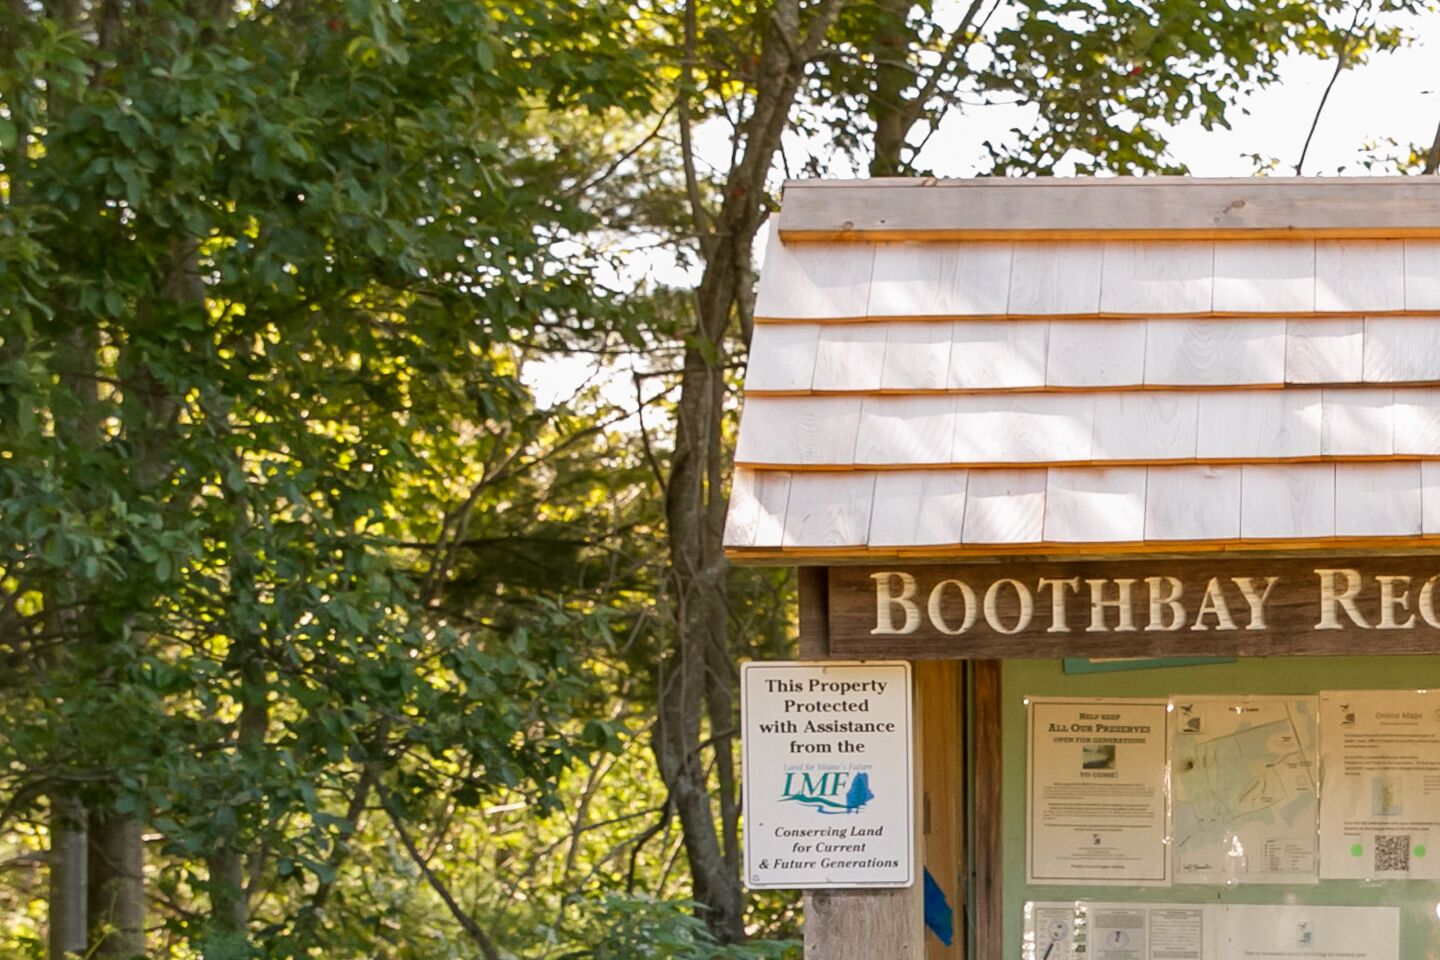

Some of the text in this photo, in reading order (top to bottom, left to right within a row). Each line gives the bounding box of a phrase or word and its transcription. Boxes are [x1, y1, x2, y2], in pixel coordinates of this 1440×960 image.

[869, 571, 1280, 635] BOOTHBAY
[764, 678, 888, 696] This Property
[783, 698, 869, 713] Protected
[759, 719, 896, 734] with Assistance
[1048, 723, 1152, 734] ALL OUR PRESERVES
[789, 739, 866, 754] from the
[780, 771, 850, 797] LMF
[774, 825, 884, 840] Conserving Land
[792, 842, 867, 854] for Current
[758, 857, 900, 870] & Future Generations
